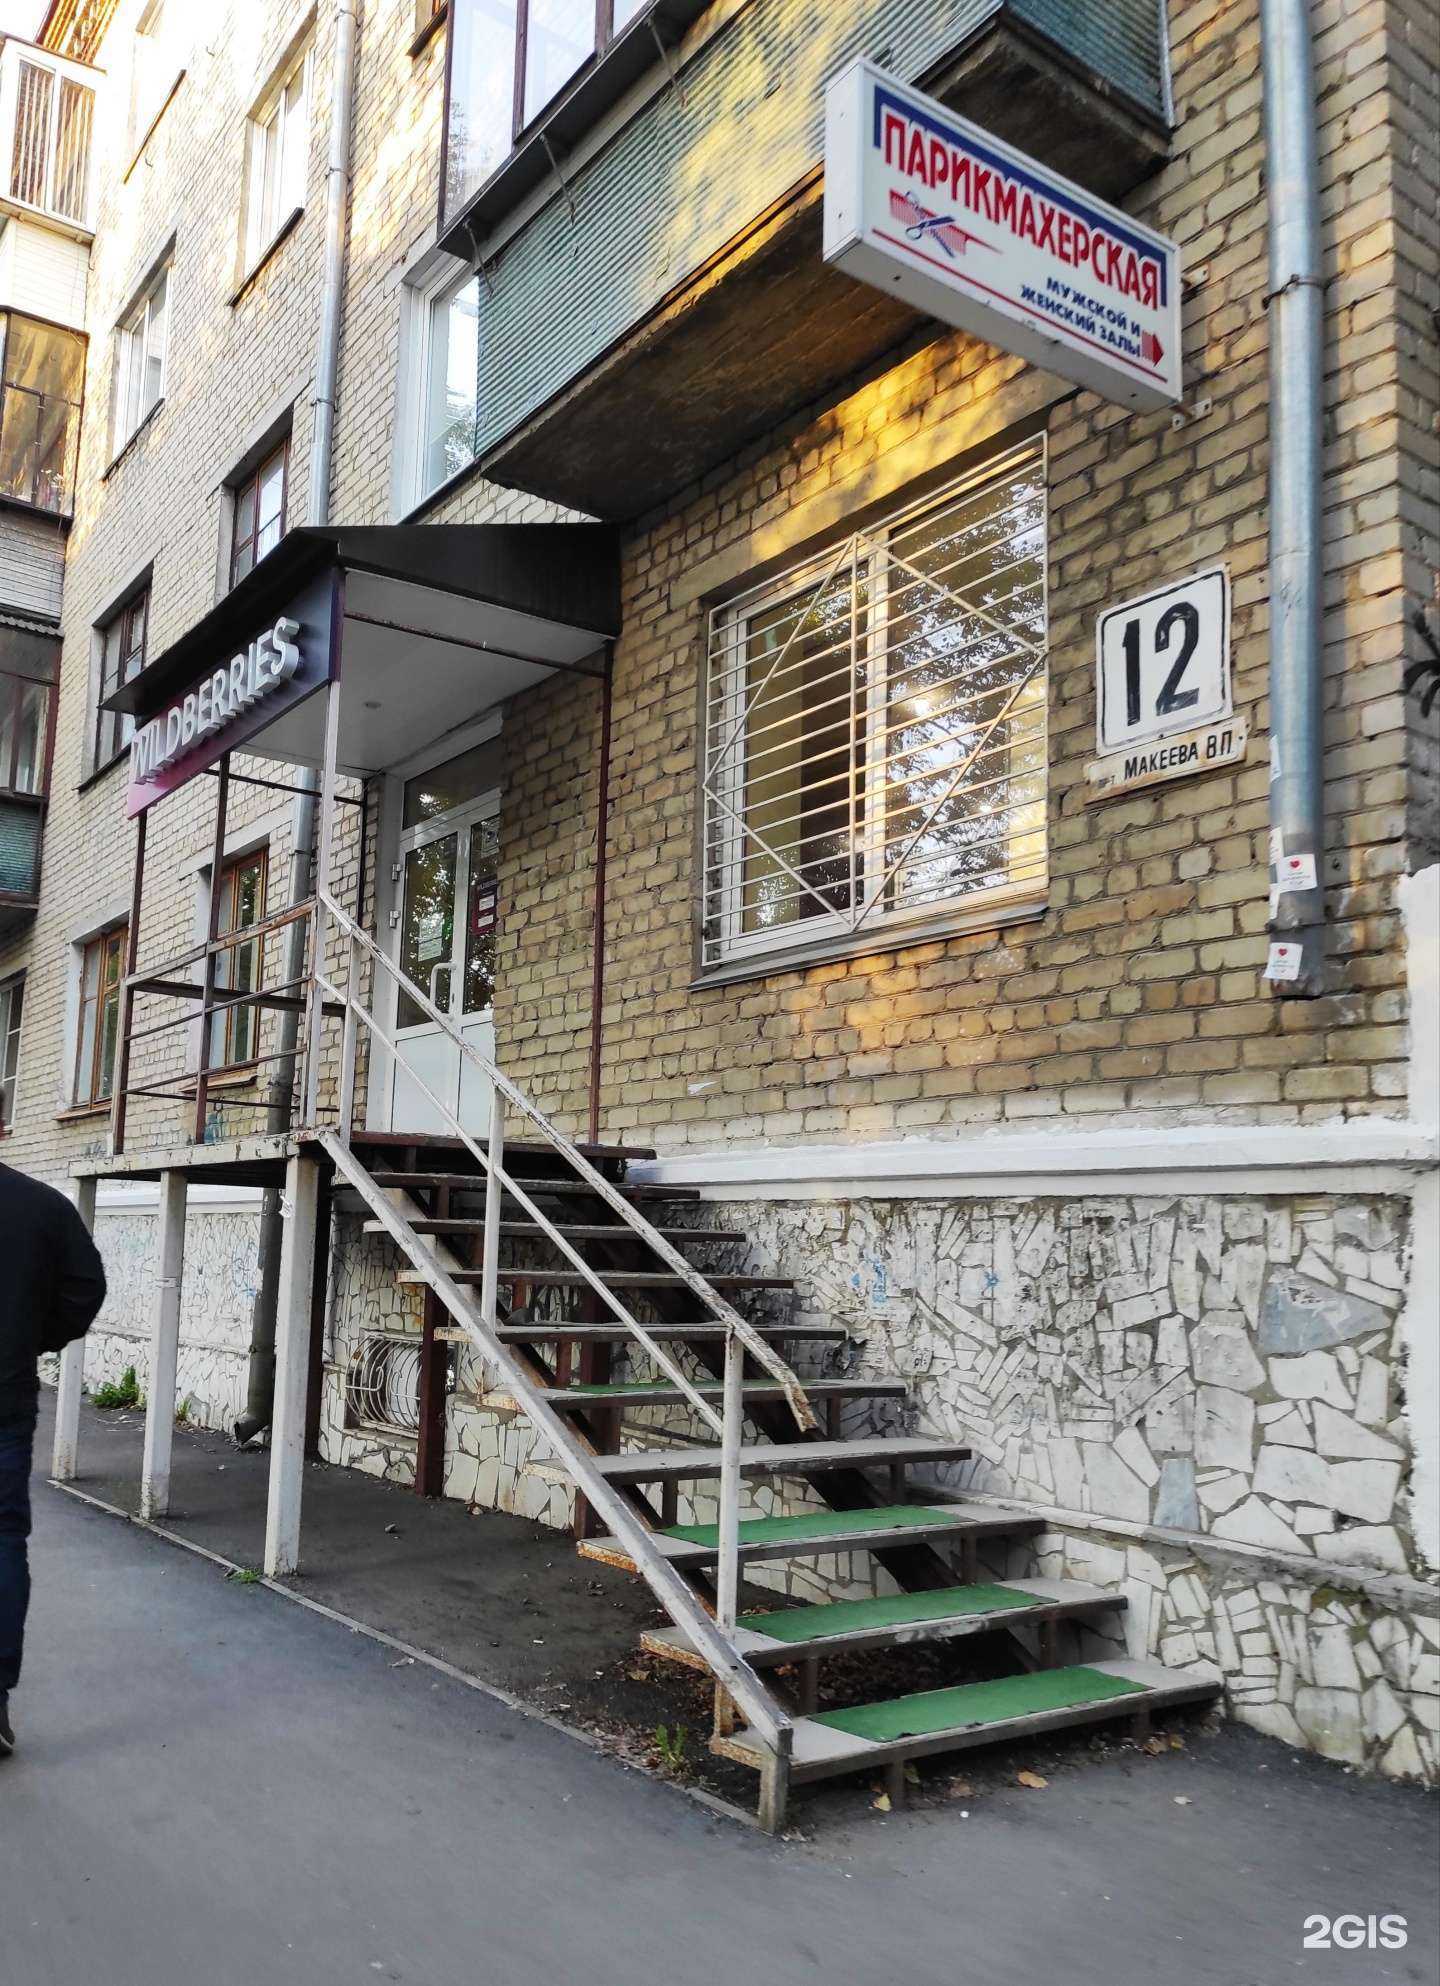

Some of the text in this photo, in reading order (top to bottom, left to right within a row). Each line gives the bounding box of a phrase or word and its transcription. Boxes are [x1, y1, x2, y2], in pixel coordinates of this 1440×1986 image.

[884, 113, 1158, 310] ПАРИКМАХЕРСКАЯ
[1020, 284, 1141, 358] ЖЕНСКИЙ ЗАЛЫ
[1046, 276, 1141, 337] МУЖСКОЙ И
[130, 616, 300, 784] WILDBERRIES
[1122, 601, 1200, 727] 12
[1124, 741, 1198, 780] МАКЕЕВА
